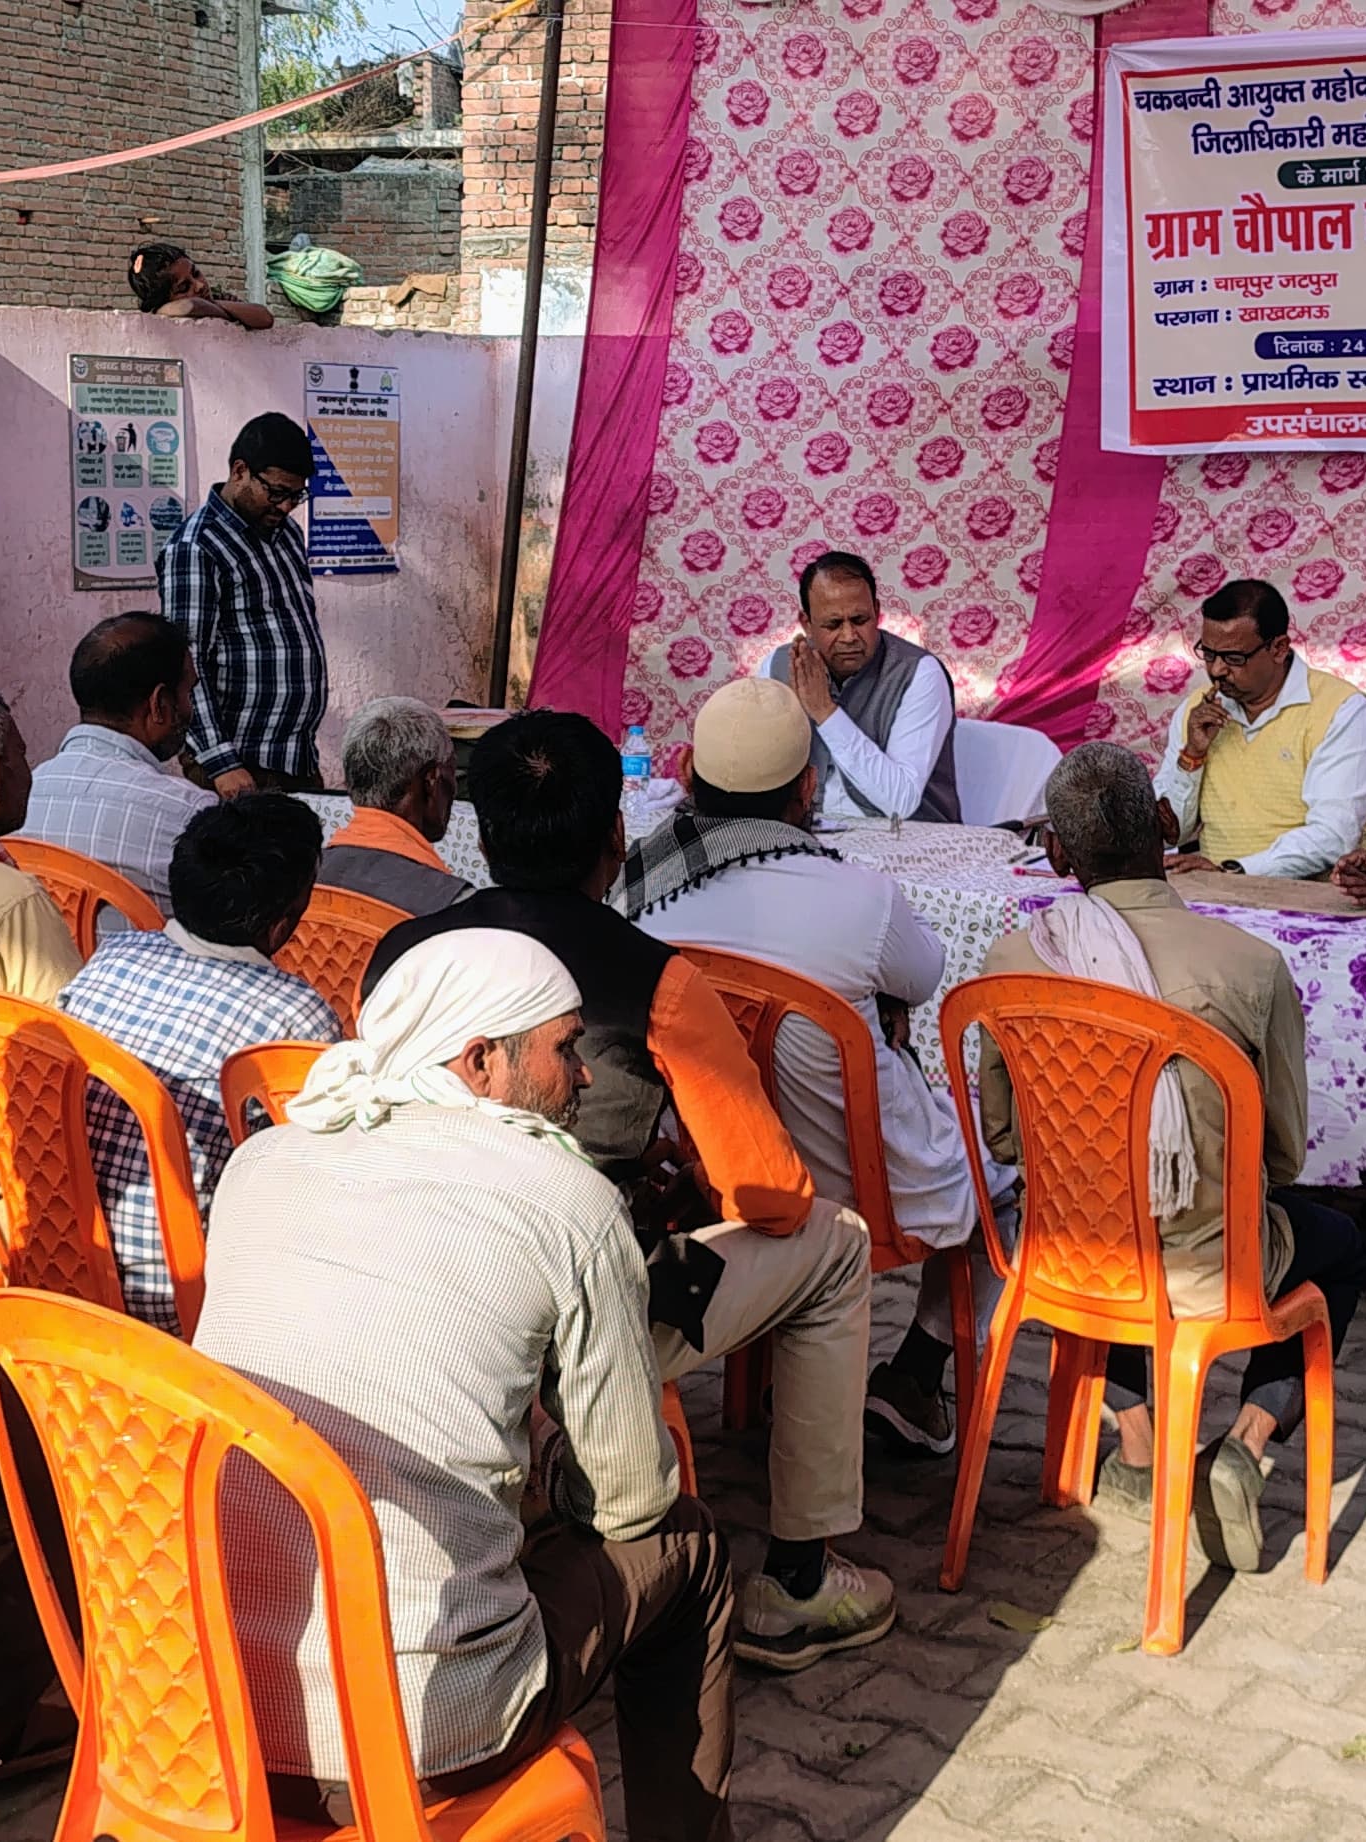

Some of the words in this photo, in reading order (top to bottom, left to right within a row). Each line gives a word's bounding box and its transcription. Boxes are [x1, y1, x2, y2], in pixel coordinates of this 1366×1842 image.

[1134, 77, 1221, 112] चकबन्दी
[1227, 80, 1306, 117] आयुक्त
[1191, 116, 1325, 155] जिलाधिकारी
[1296, 163, 1315, 186] के
[1319, 160, 1361, 185] मार्ग
[1145, 210, 1222, 261] ग्राम
[1233, 193, 1355, 253] चौपाल
[1154, 279, 1194, 299] ग्राम
[1214, 275, 1275, 298] चाचूपुर
[1278, 273, 1338, 295] जटपुरा
[1155, 309, 1219, 327] परगना
[1273, 336, 1325, 355] दिनांक
[1342, 339, 1365, 353] 24
[1153, 375, 1216, 397] स्थान
[1242, 364, 1341, 395] प्राथमिक
